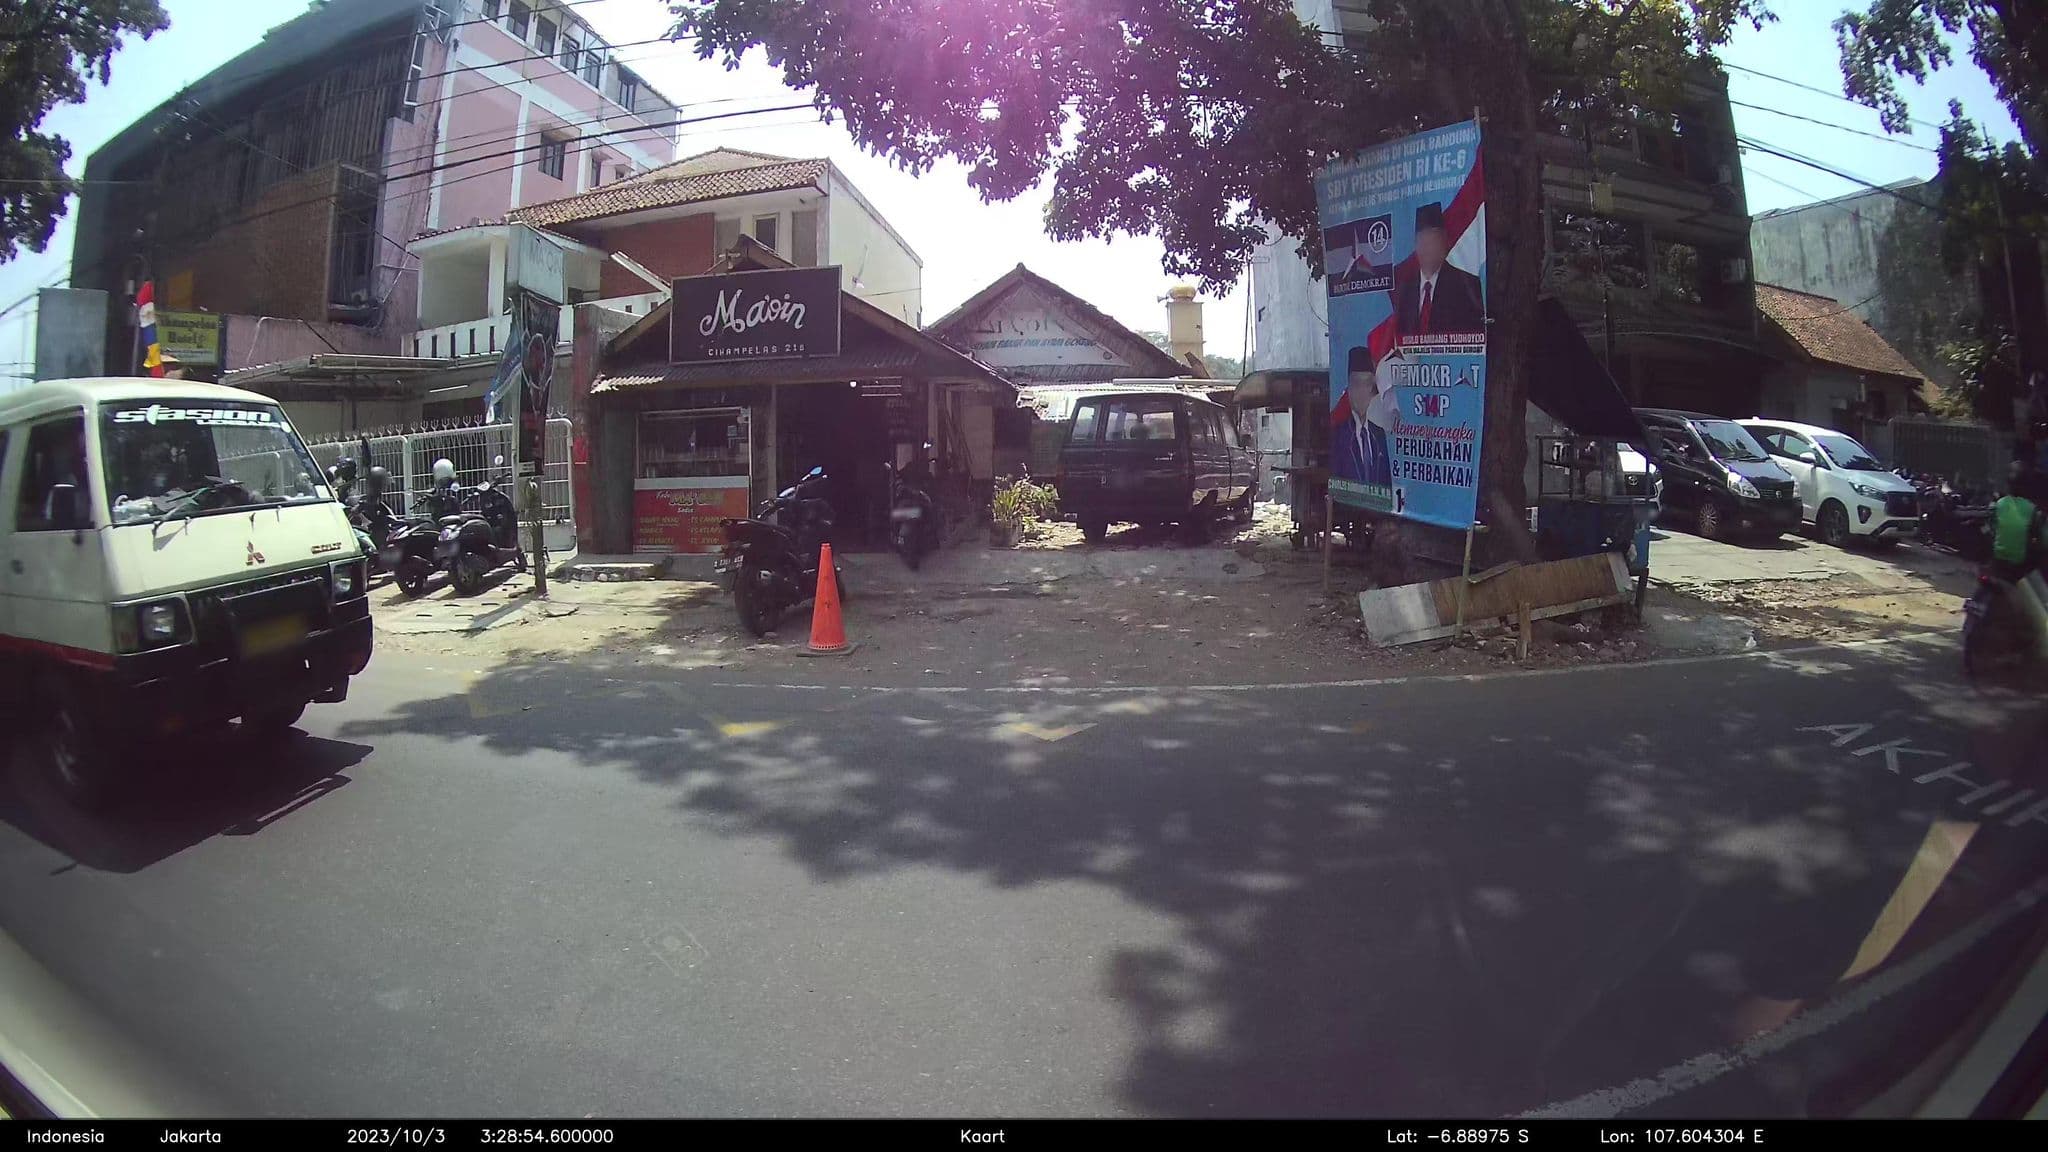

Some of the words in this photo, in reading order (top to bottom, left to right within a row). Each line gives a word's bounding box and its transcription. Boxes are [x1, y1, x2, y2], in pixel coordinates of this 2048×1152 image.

[1352, 161, 1412, 193] PRESIDEN
[1416, 156, 1429, 177] RI
[1371, 226, 1386, 247] 14
[1351, 276, 1390, 290] DEMOKRAT
[708, 345, 777, 357] CIHAMPELAS
[113, 404, 271, 425] stasion
[1395, 437, 1472, 463] PERUBAHAN
[1392, 459, 1400, 477] &
[1403, 460, 1473, 488] PERBAIKAN
[311, 542, 342, 555] COLT
